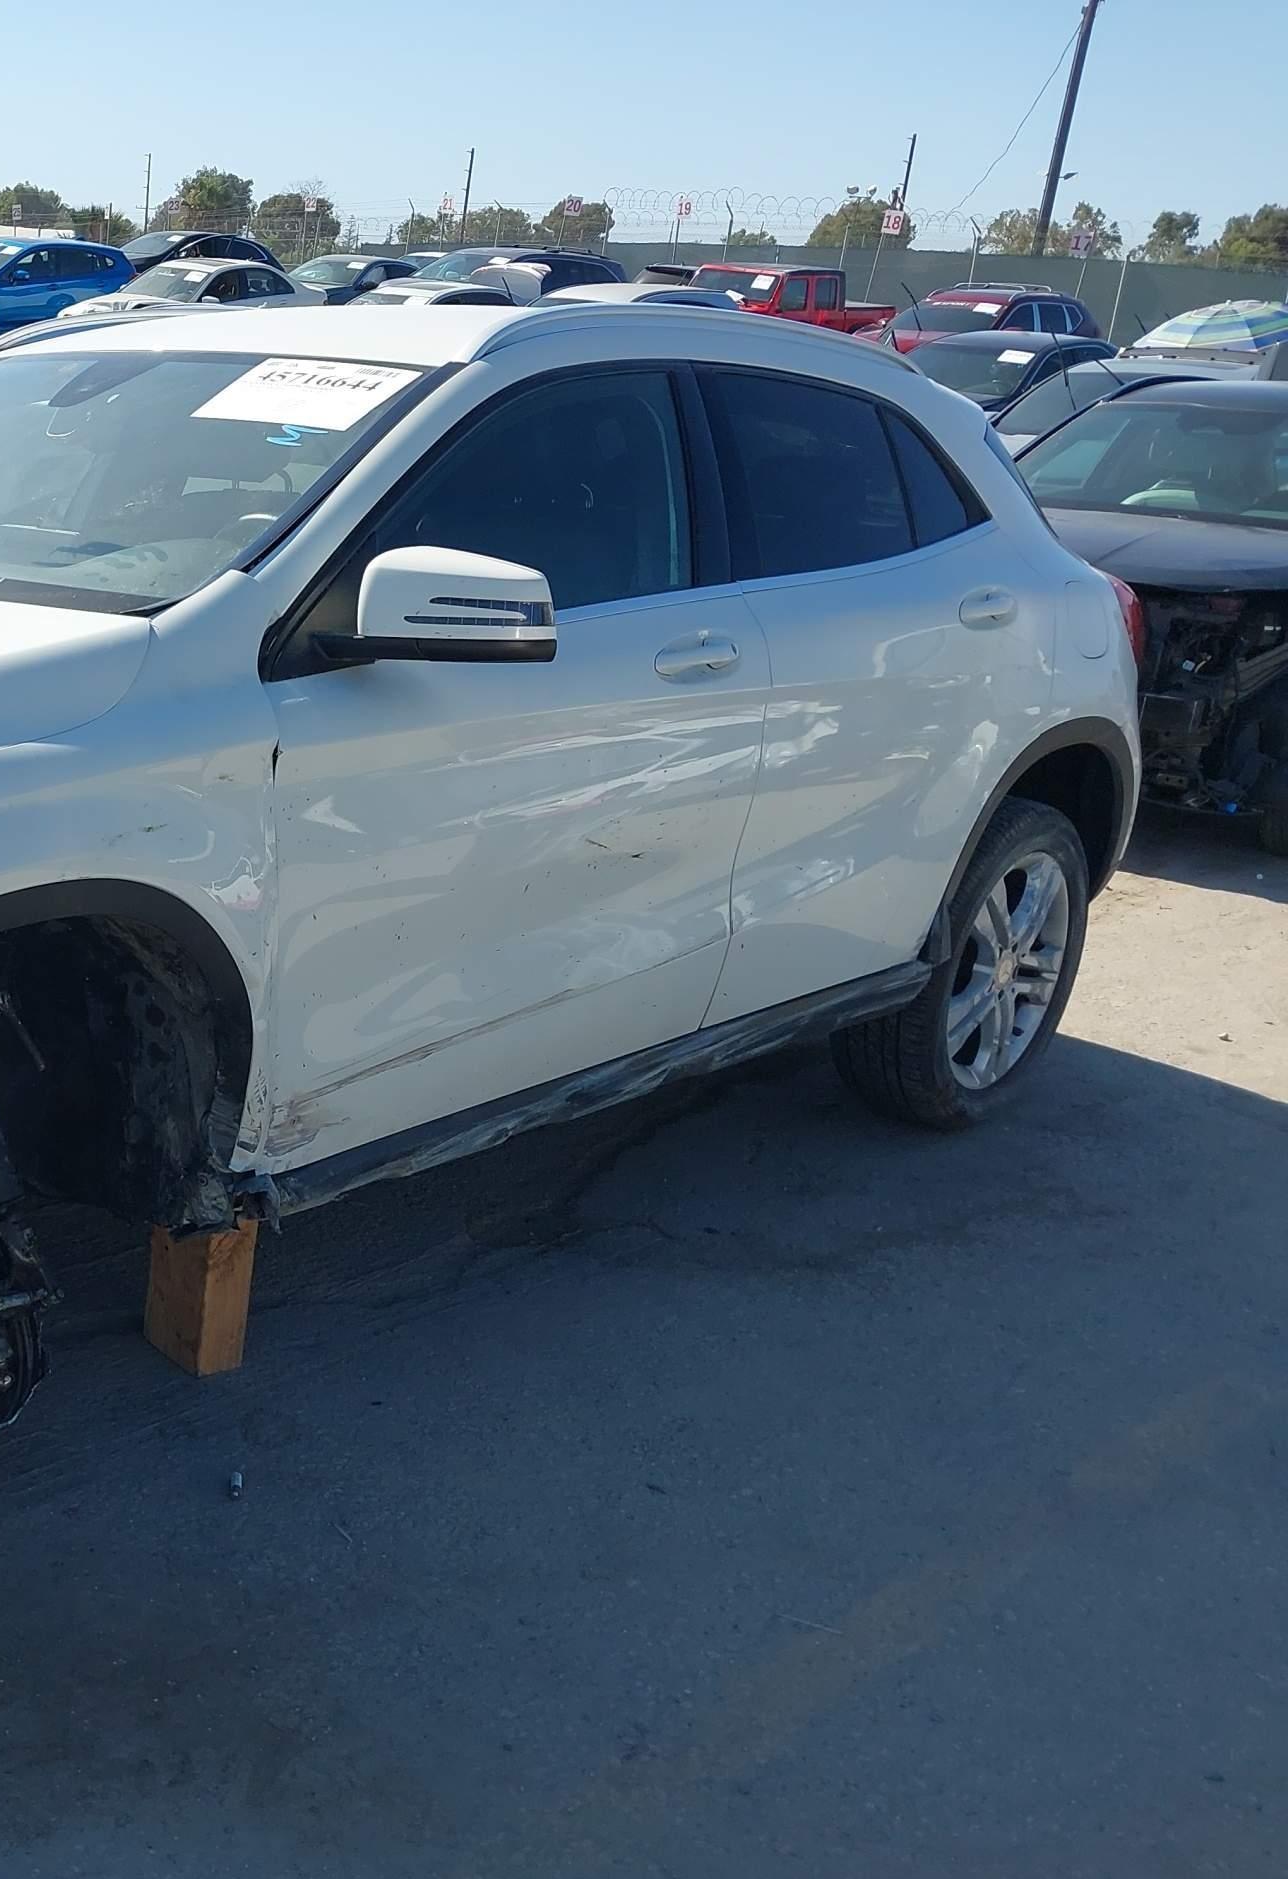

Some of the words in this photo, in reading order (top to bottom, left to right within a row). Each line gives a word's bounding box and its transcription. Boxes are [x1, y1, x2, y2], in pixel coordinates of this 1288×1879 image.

[168, 200, 179, 211] 23
[306, 197, 316, 209] 22
[443, 198, 453, 210] 21
[565, 199, 582, 213] 20
[677, 201, 692, 216] 19
[883, 215, 902, 230] 18
[1071, 235, 1092, 251] 17
[258, 370, 383, 392] 45716644
